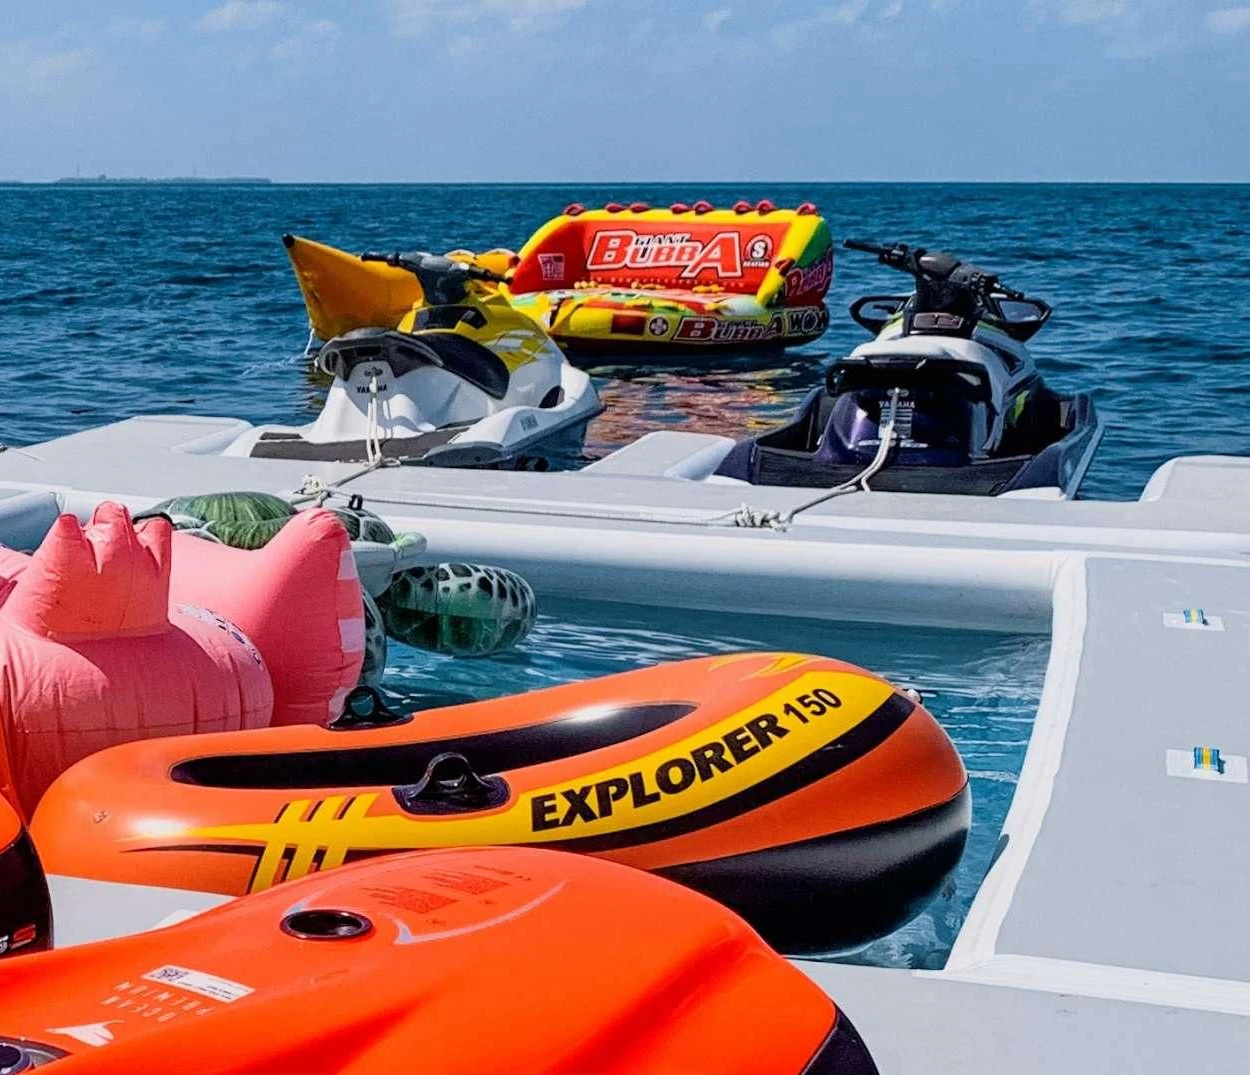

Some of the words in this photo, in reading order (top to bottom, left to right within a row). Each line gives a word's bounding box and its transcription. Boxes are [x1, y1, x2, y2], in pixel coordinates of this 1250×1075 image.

[356, 384, 388, 394] YAHA
[878, 401, 916, 409] YAAHA
[530, 712, 790, 832] EXPLORER
[783, 688, 843, 724] 150
